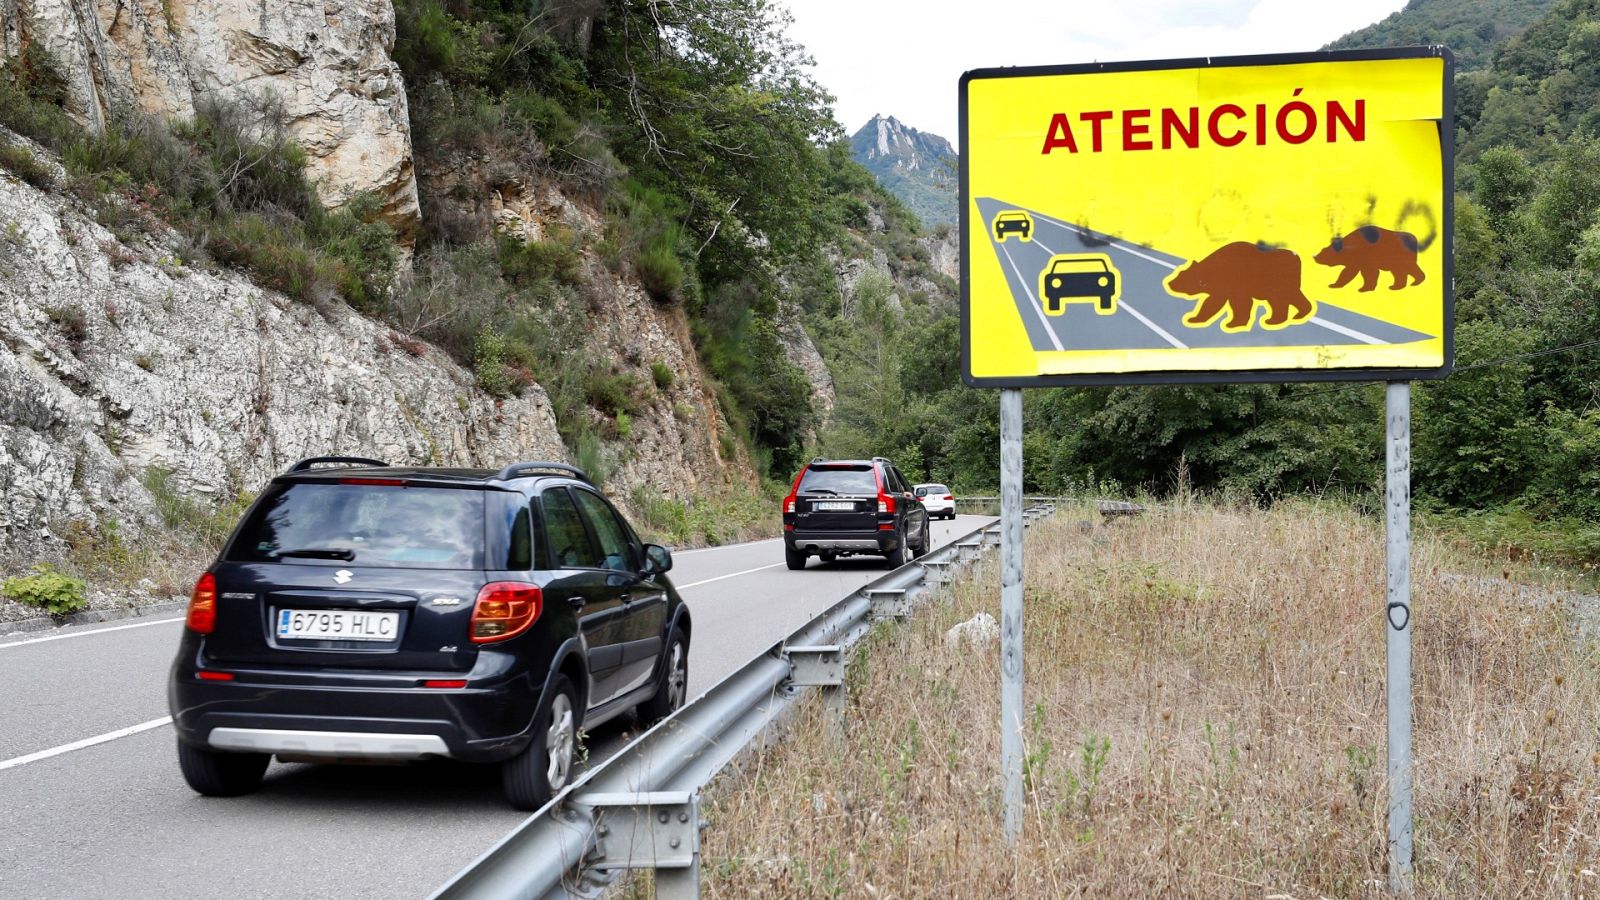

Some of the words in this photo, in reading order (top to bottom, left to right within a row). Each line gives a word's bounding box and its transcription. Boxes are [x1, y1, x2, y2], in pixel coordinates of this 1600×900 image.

[1041, 88, 1366, 155] ATENCIÓN
[293, 613, 343, 633] 6795
[351, 615, 391, 635] HLC
